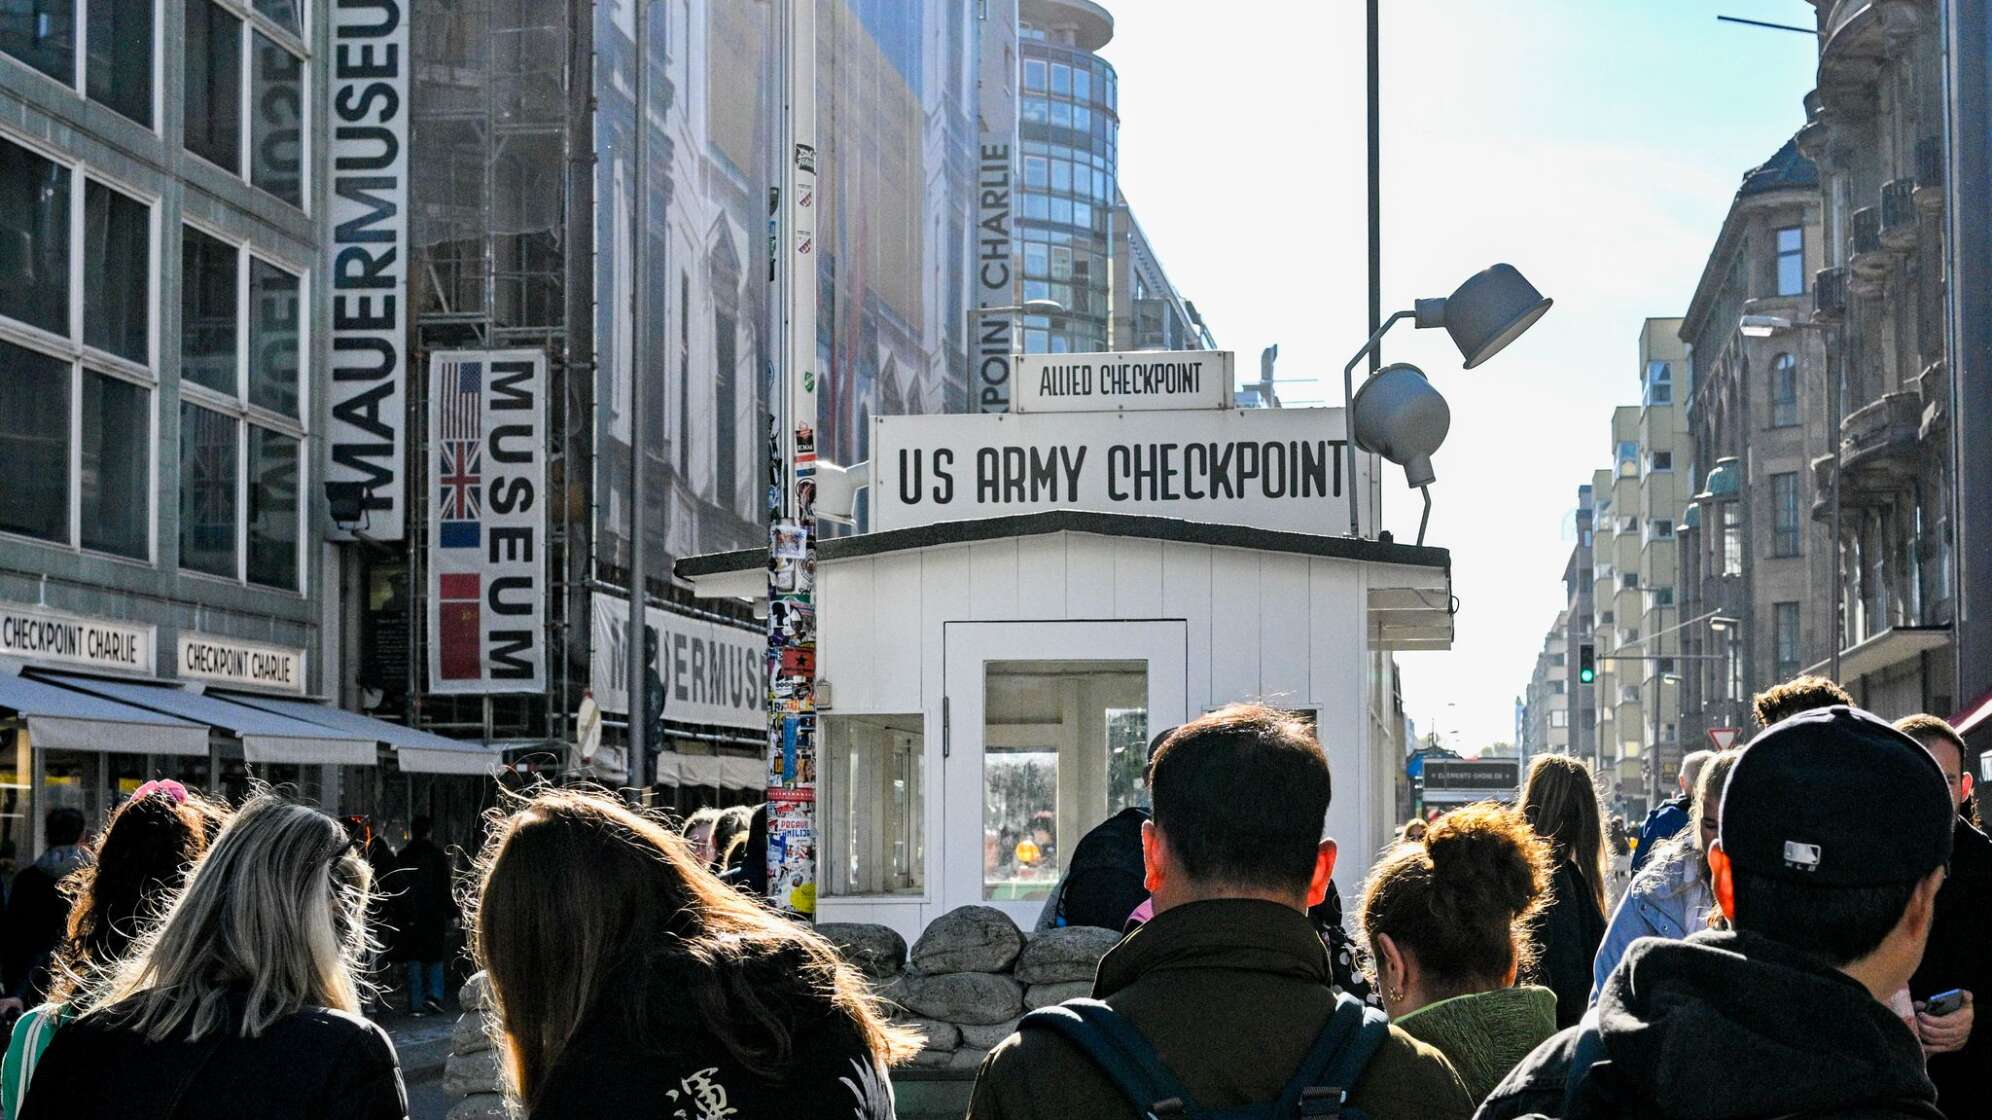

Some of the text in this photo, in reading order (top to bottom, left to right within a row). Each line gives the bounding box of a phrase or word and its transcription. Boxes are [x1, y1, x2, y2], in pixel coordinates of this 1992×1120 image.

[981, 144, 1010, 289] CHARLIE
[1040, 362, 1202, 397] ALLIED CHECKPOINT
[899, 440, 1348, 505] US ARMY CHECKPOINT
[488, 361, 535, 680] MUSEUM
[3, 616, 136, 663] CHECKPOINT CHARLIE
[186, 643, 291, 682] CHECKPOINT CHARLIE
[610, 617, 768, 711] MUERMUSE
